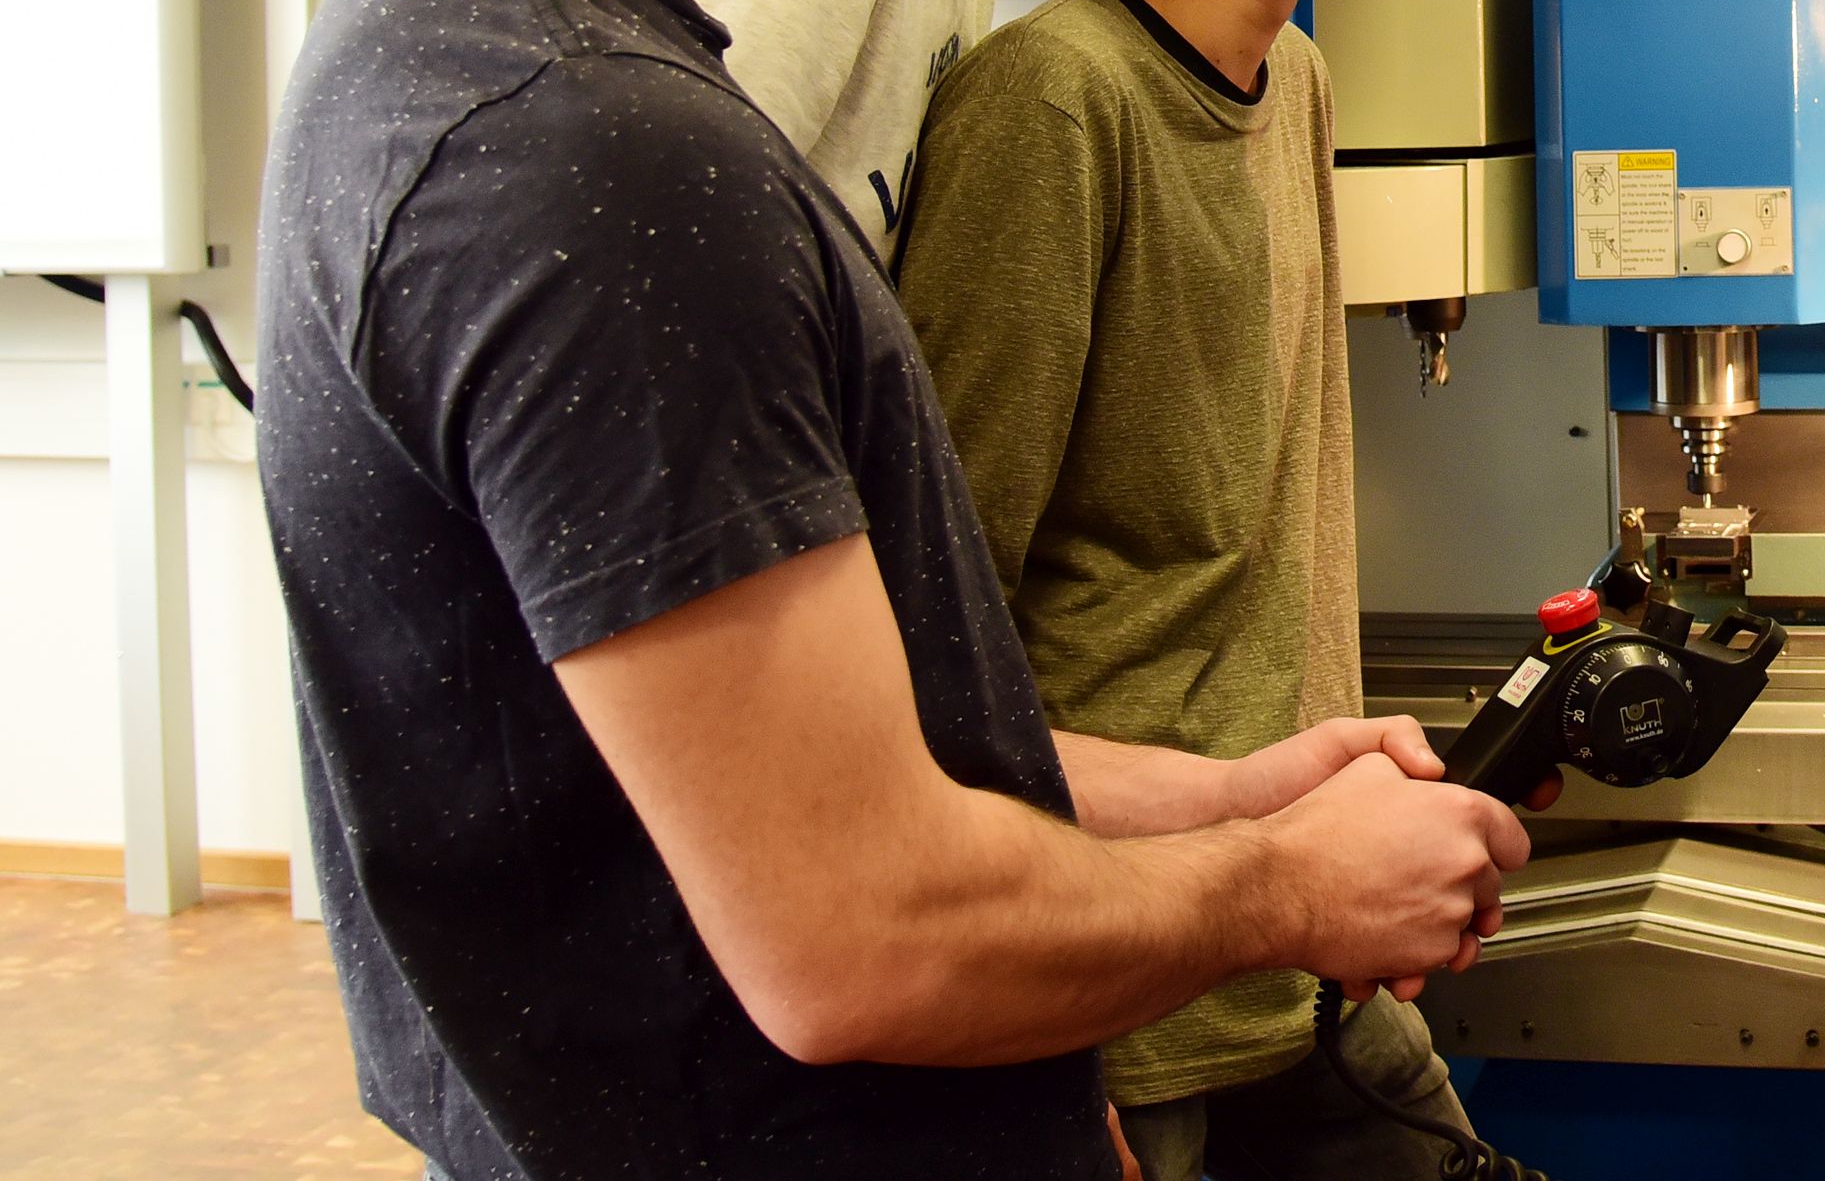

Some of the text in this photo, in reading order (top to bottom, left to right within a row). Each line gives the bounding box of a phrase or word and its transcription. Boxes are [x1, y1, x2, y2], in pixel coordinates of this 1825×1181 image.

[1636, 157, 1671, 166] WARNING
[1588, 673, 1602, 686] 10
[1573, 709, 1585, 724] 20
[1623, 720, 1662, 735] KNUTH
